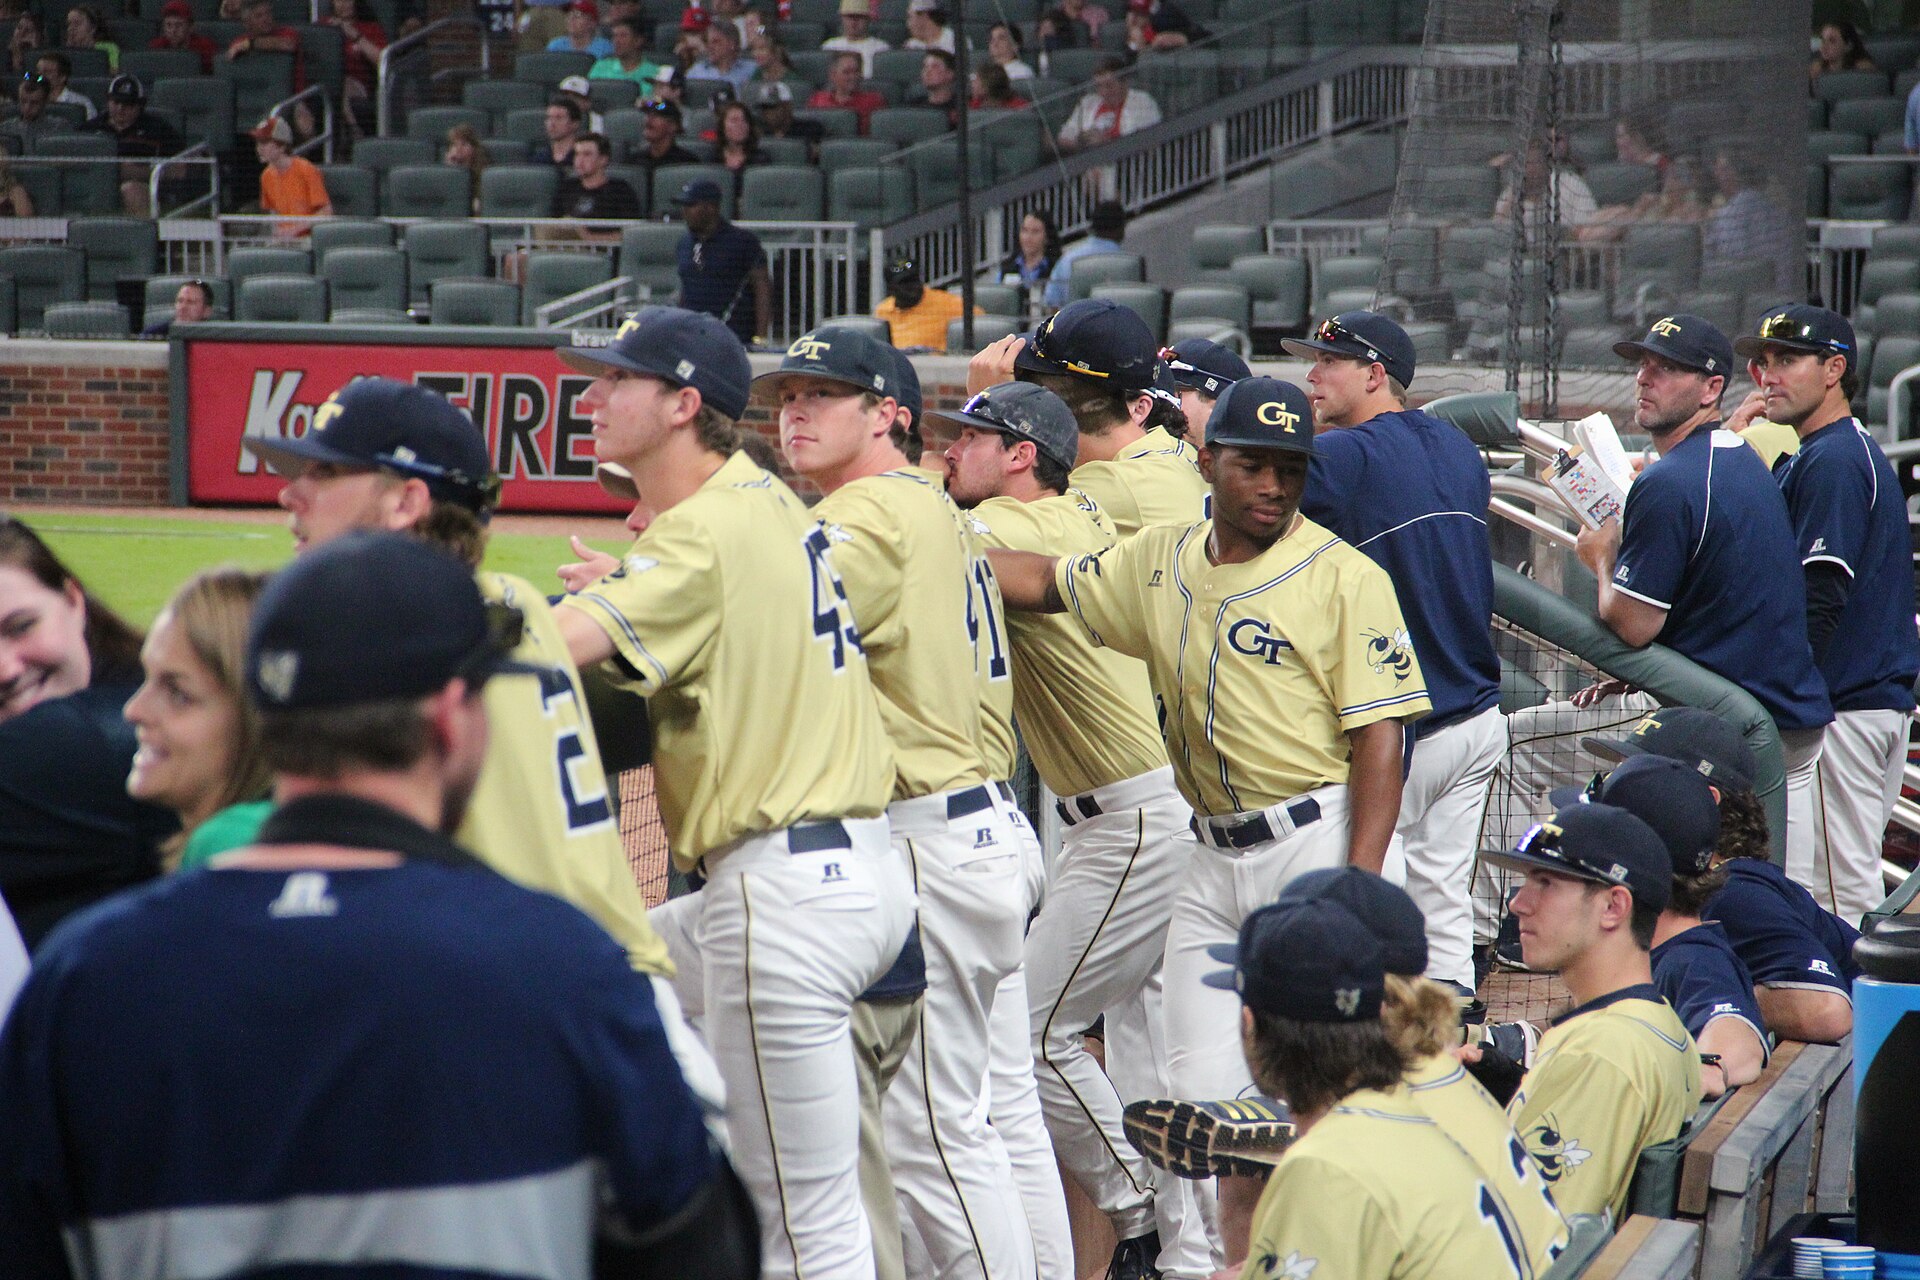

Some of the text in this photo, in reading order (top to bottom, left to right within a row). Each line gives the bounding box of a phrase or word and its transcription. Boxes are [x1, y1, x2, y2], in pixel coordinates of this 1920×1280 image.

[1651, 316, 1682, 338] GT
[787, 335, 831, 360] GT
[1256, 401, 1300, 433] GT
[1227, 617, 1295, 666] GT
